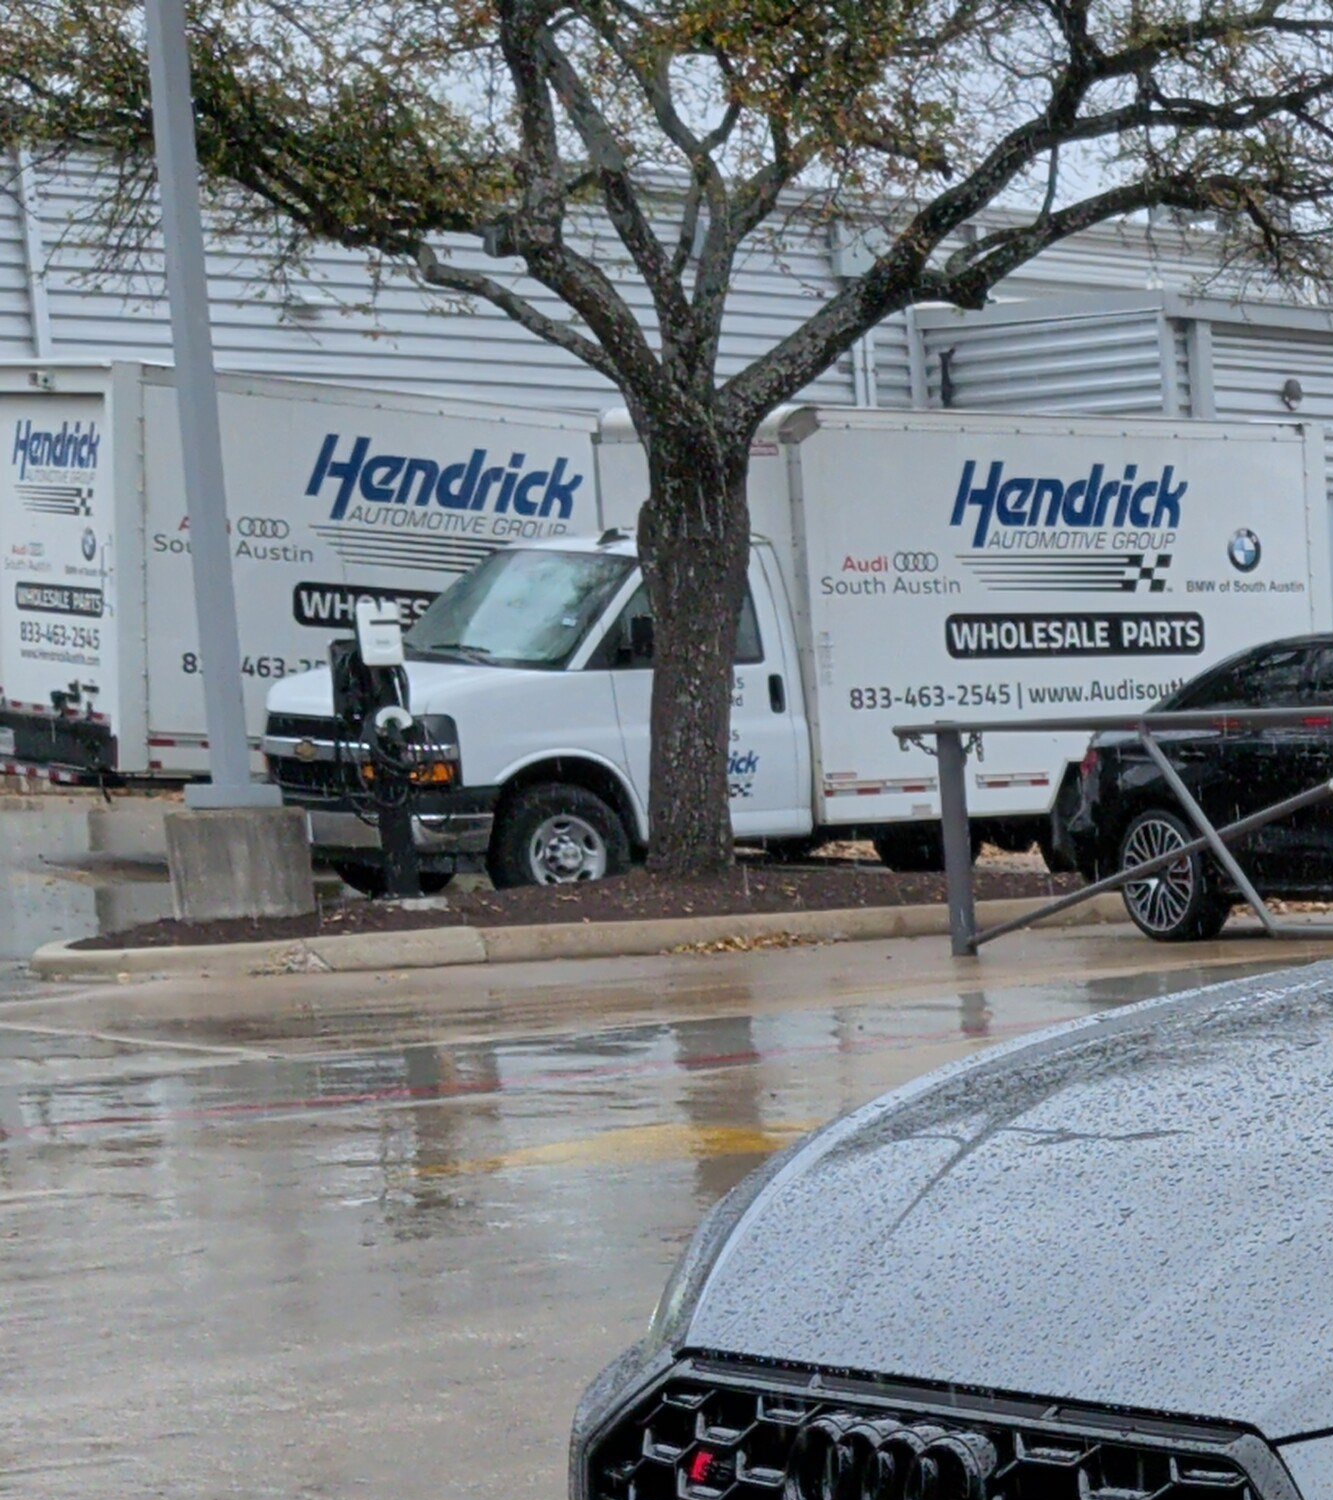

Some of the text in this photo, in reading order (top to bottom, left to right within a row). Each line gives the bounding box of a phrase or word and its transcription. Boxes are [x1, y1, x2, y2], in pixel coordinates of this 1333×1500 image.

[12, 419, 100, 480] Hendrick
[305, 433, 583, 520] Hendrick
[950, 460, 1188, 548] Hendrick
[348, 505, 567, 538] AUTOMOTIVE GROUP
[236, 541, 313, 563] Austin
[987, 531, 1176, 549] AUTOMOTIVE GROUP
[842, 556, 888, 572] Audi
[821, 576, 961, 595] South Austin
[1186, 581, 1304, 592] BMW of South Austin
[20, 620, 100, 650] 833-463-2545
[951, 620, 1201, 650] WHOLESALE PARTS
[849, 682, 1011, 709] 833-463-2545
